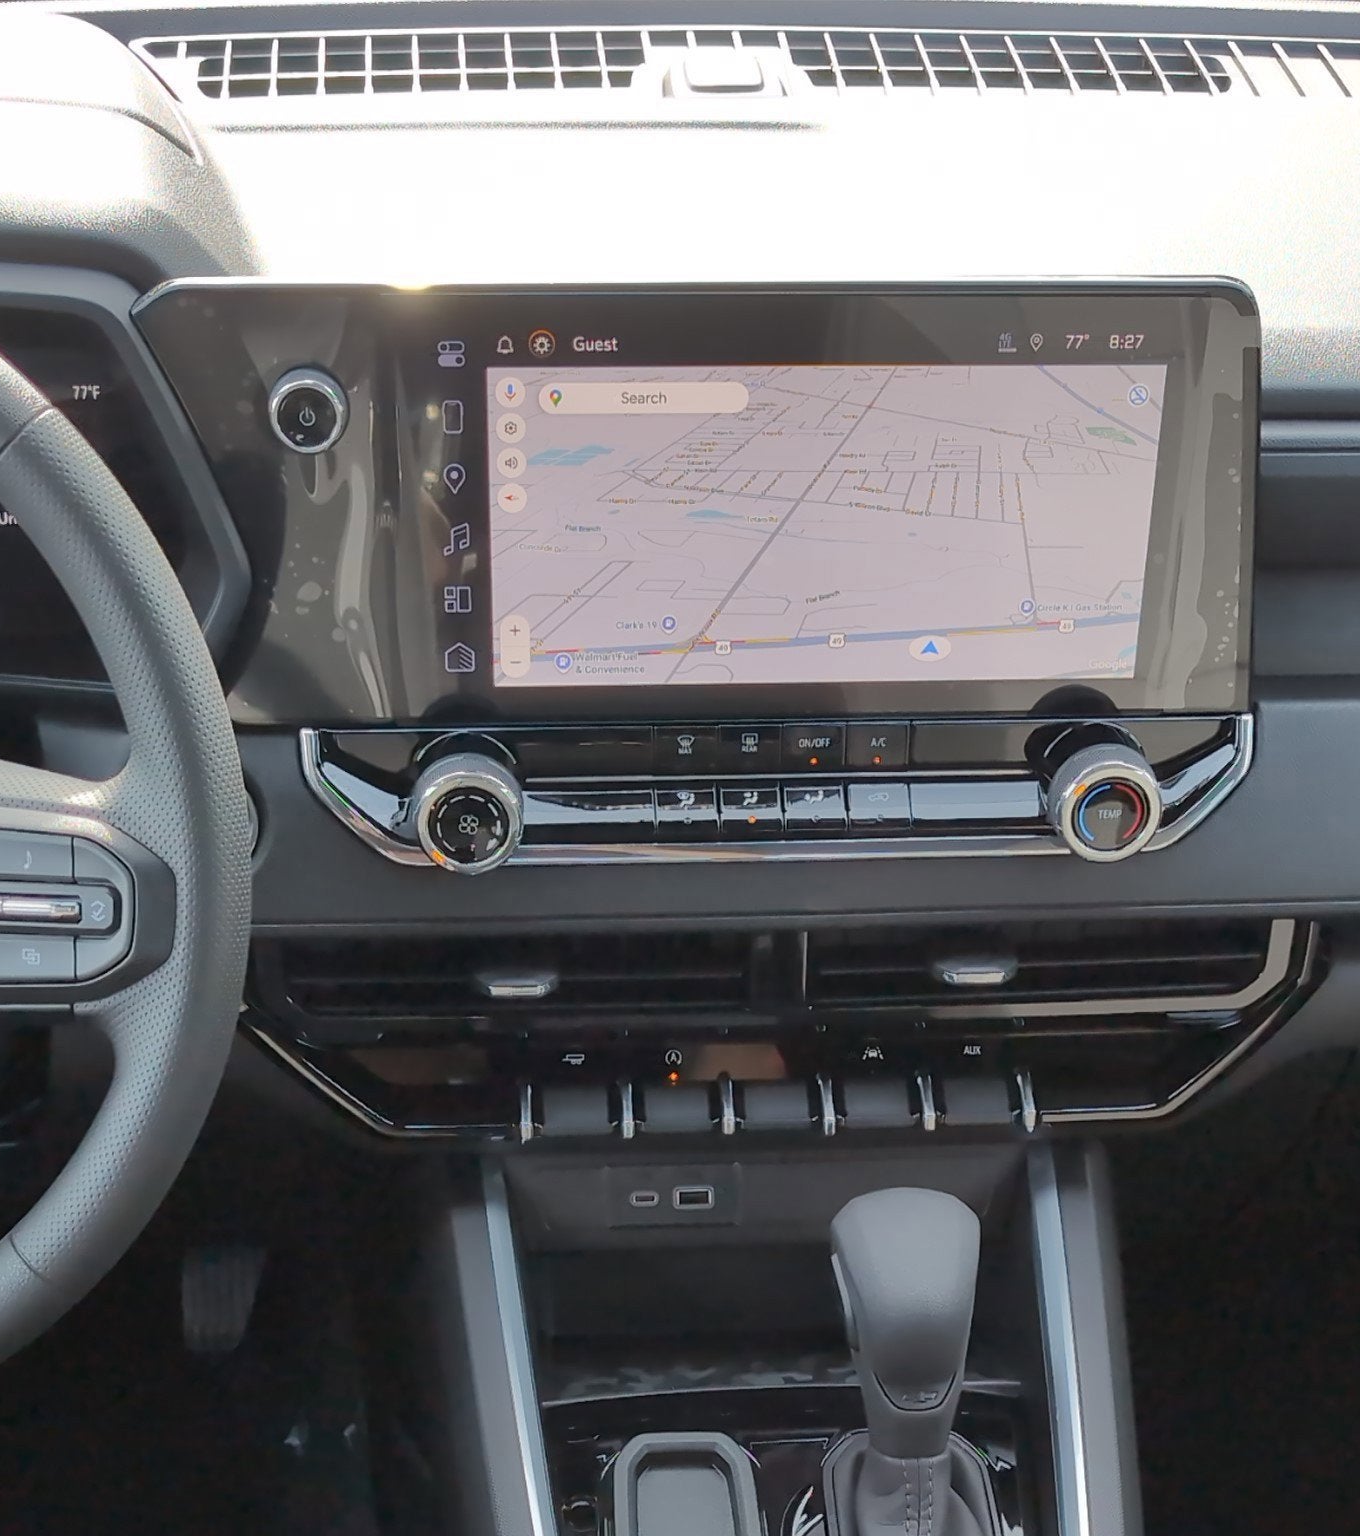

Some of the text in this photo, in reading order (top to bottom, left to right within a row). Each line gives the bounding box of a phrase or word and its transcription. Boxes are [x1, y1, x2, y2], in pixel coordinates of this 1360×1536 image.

[573, 336, 619, 352] Guest
[1065, 334, 1090, 349] 77°
[1109, 334, 1144, 349] 8:27
[72, 385, 101, 400] 77°F
[621, 391, 668, 405] Search
[1075, 603, 1091, 612] Gas
[1094, 602, 1123, 612] Station
[584, 665, 645, 675] Convenience
[1089, 658, 1127, 671] Google
[798, 737, 831, 748] ON/OFF
[870, 737, 887, 748] A/C
[1098, 809, 1123, 820] TEMP
[962, 1045, 981, 1056] AUX
